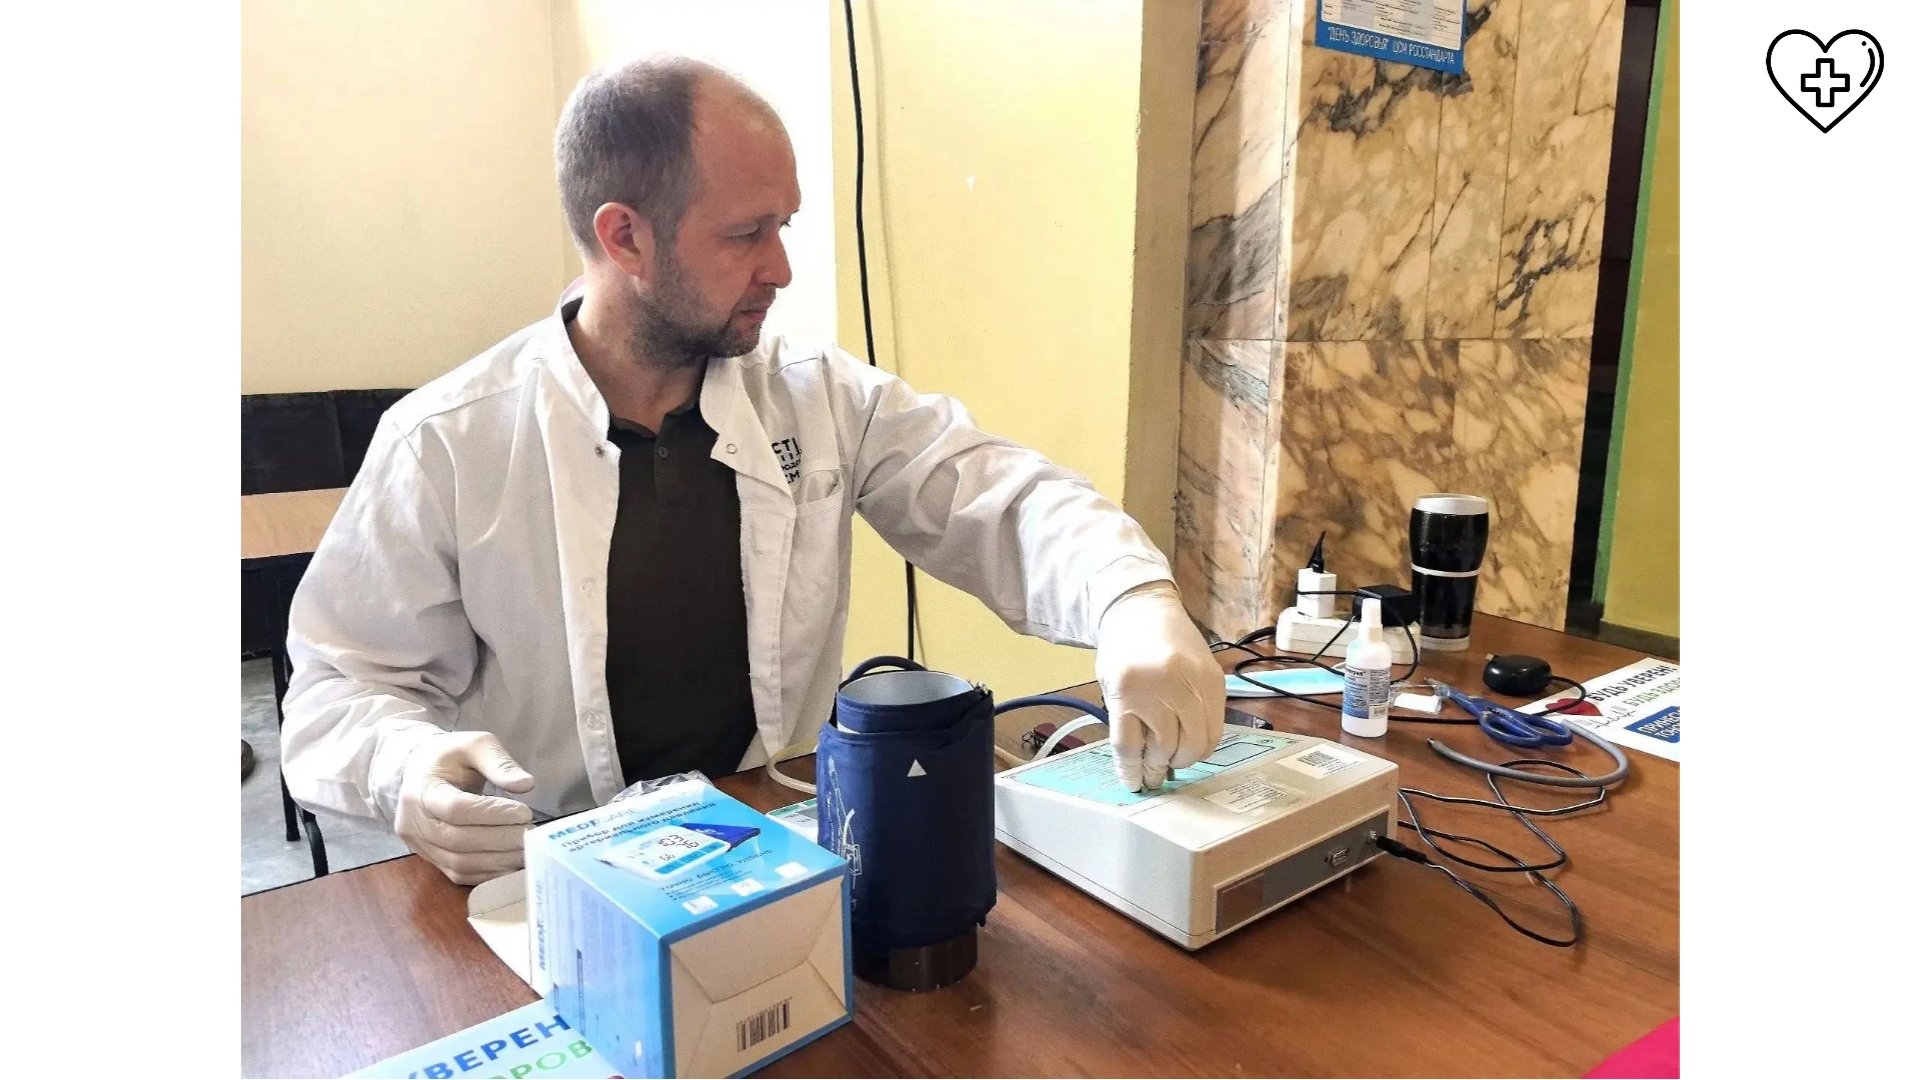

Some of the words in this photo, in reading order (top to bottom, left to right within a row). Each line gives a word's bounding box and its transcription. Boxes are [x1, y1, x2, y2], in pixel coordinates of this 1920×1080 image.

[1588, 685, 1628, 701] БУДЬ
[561, 828, 610, 848] Прибор
[612, 821, 636, 832] для
[408, 1013, 571, 1079] ВЕРЕН
